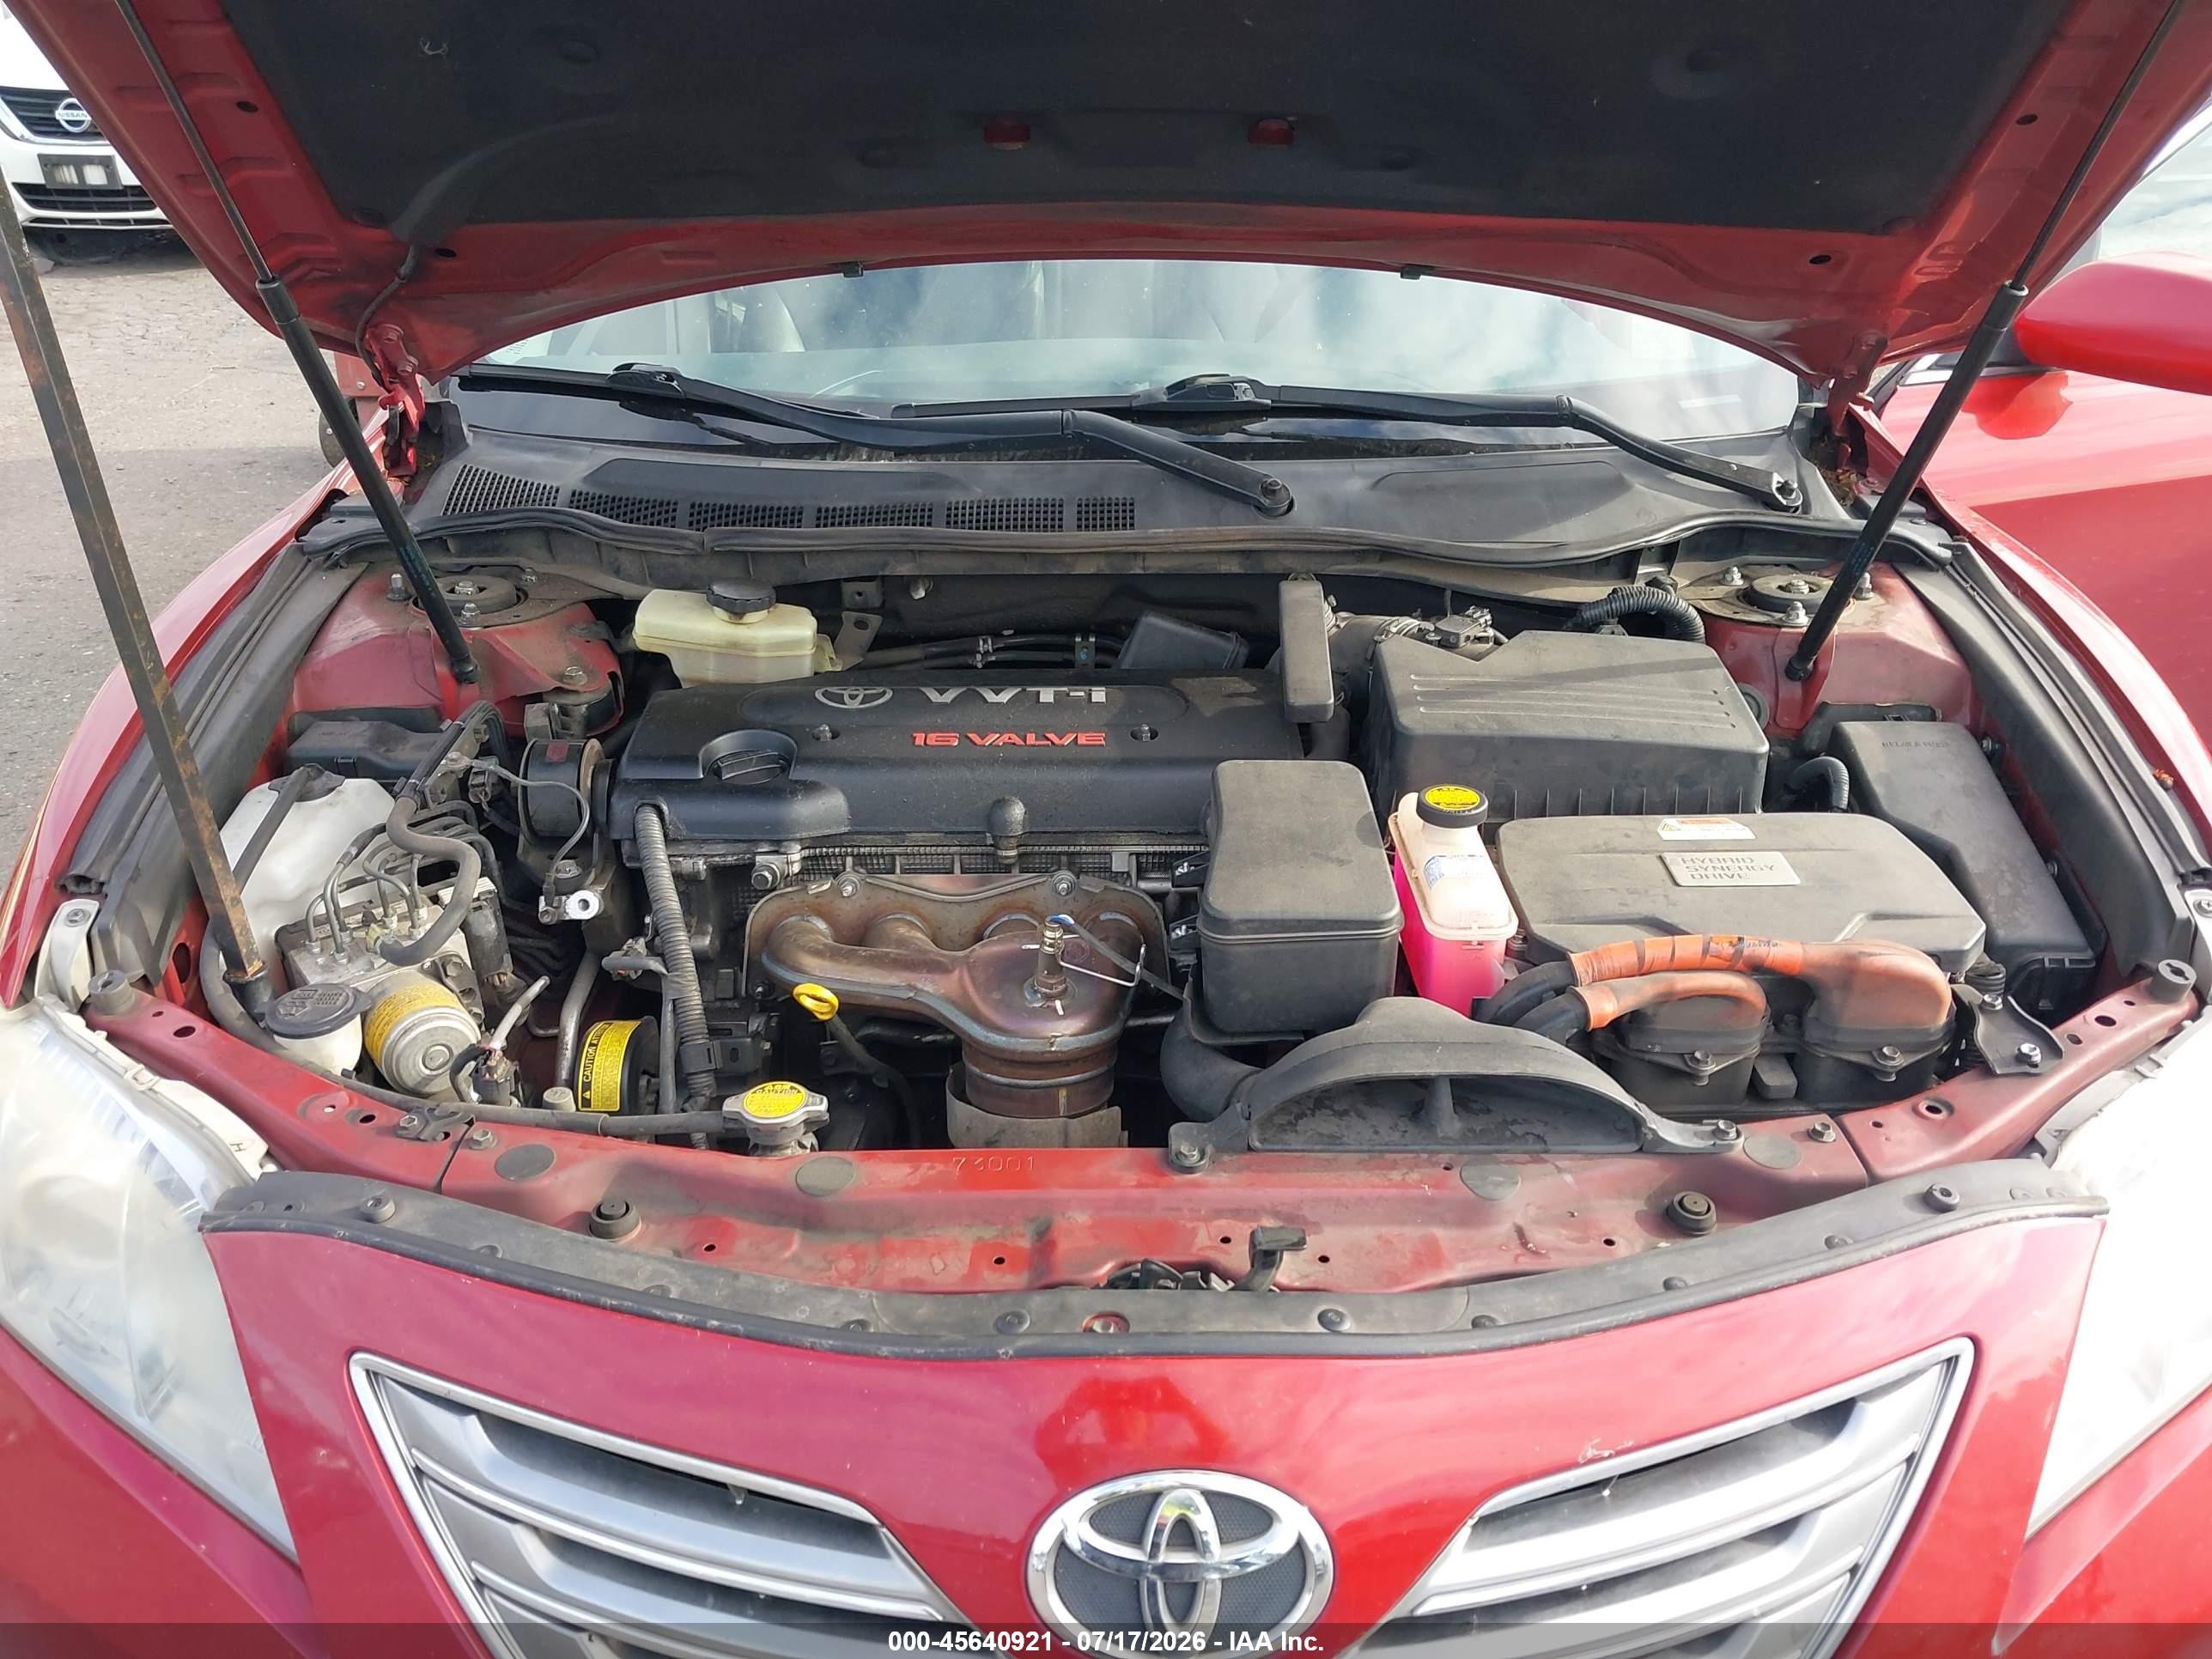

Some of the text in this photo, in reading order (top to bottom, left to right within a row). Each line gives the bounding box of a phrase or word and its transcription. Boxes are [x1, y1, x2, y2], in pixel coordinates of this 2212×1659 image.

[912, 732, 1106, 747] 16 VALVE
[583, 1045, 597, 1083] CAUTION
